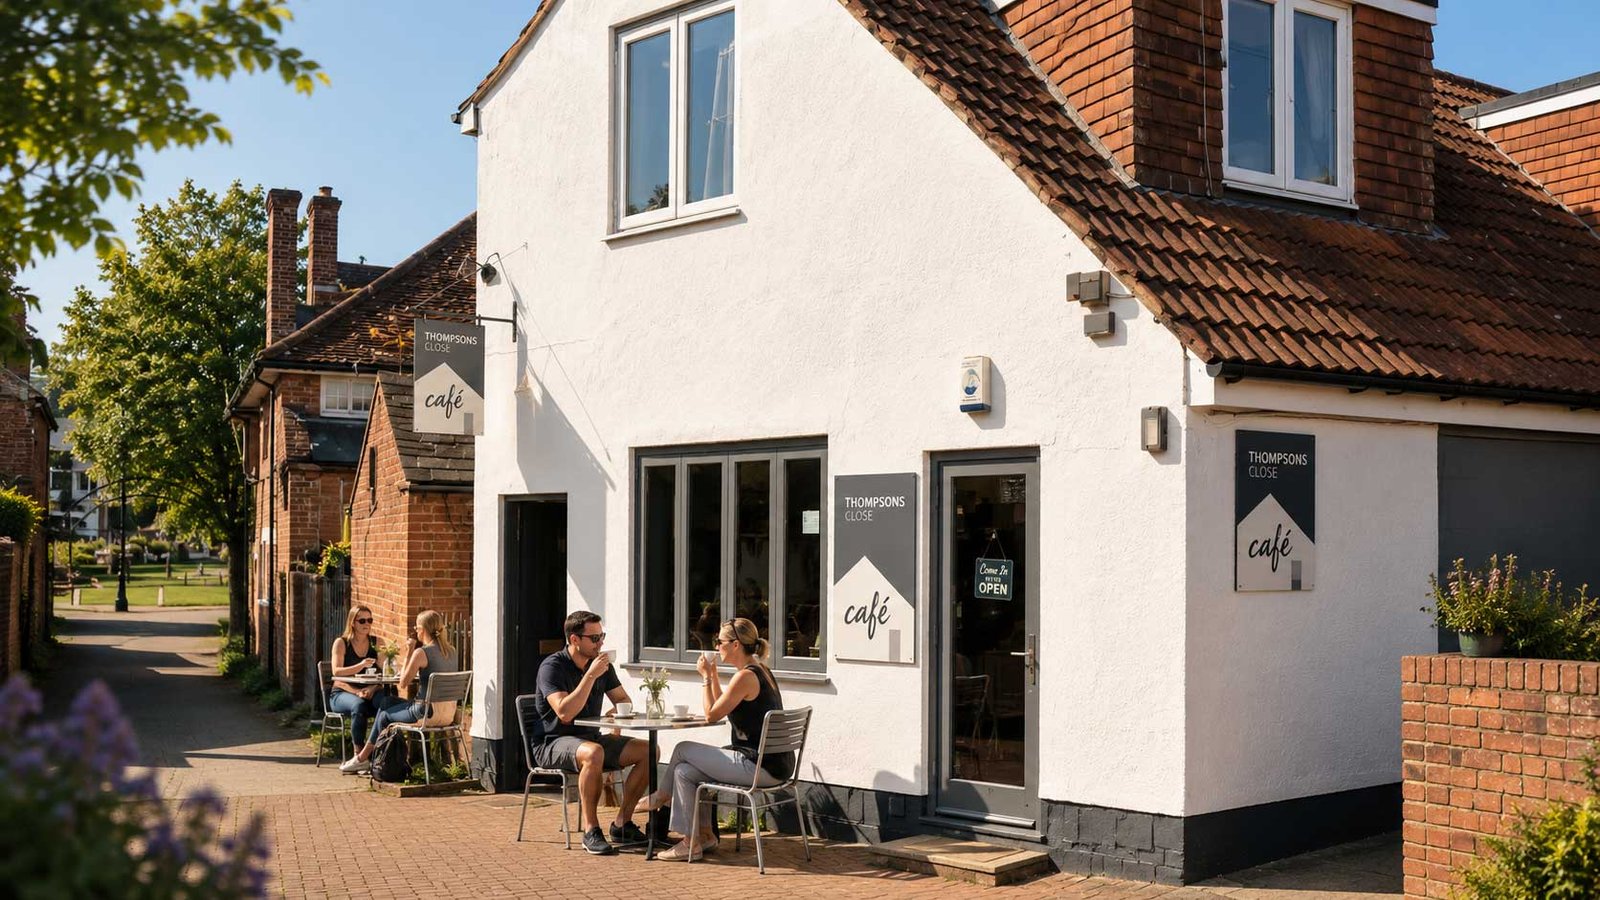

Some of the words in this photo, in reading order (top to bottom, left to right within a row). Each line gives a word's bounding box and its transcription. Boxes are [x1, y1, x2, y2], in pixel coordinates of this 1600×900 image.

[424, 331, 478, 345] THOMPSONS
[424, 342, 451, 353] CLOSE
[425, 384, 464, 419] café
[1249, 451, 1308, 466] THOMPSONS
[1249, 466, 1278, 479] CLOSE
[845, 496, 905, 508] THOMPSONS
[845, 510, 873, 522] CLOSE
[1249, 523, 1293, 573] café
[980, 562, 998, 575] Come
[999, 564, 1008, 576] In
[979, 582, 1008, 595] OPEN
[844, 591, 891, 640] café
